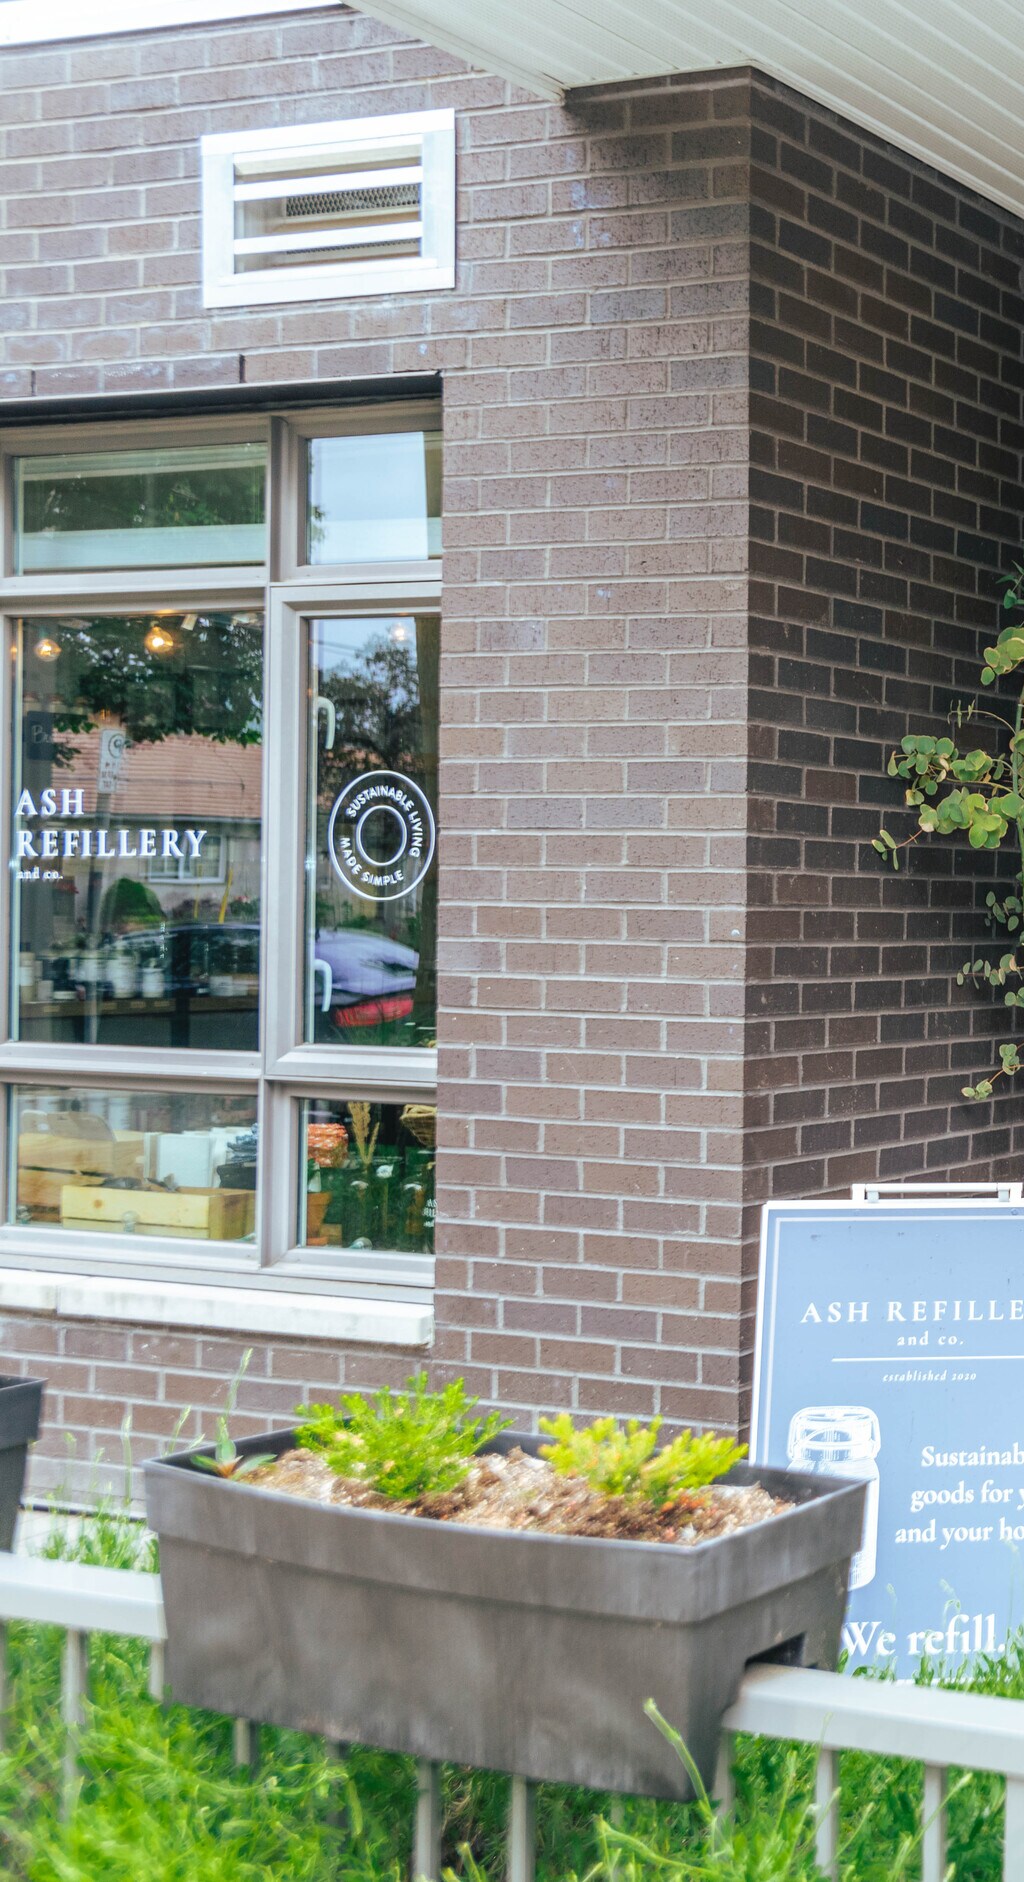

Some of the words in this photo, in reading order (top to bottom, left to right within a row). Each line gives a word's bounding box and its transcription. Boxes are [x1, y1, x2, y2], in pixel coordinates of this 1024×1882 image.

[15, 788, 85, 816] ASH
[345, 785, 415, 818] SUSTAINABLE
[408, 810, 423, 858] LIVING
[15, 829, 208, 858] REFILLERY
[15, 865, 40, 880] and
[42, 869, 64, 880] co.
[340, 837, 363, 875] MADE
[361, 869, 405, 886] SIMPLE
[799, 1301, 870, 1324] ASH
[896, 1330, 930, 1347] and
[937, 1333, 965, 1347] co.
[882, 1369, 947, 1382] established
[951, 1372, 977, 1382] 2020
[910, 1480, 975, 1513] goods
[980, 1479, 1014, 1504] for
[894, 1518, 937, 1544] and
[939, 1524, 994, 1551] your
[841, 1620, 897, 1657] We
[906, 1613, 1006, 1656] refill.
